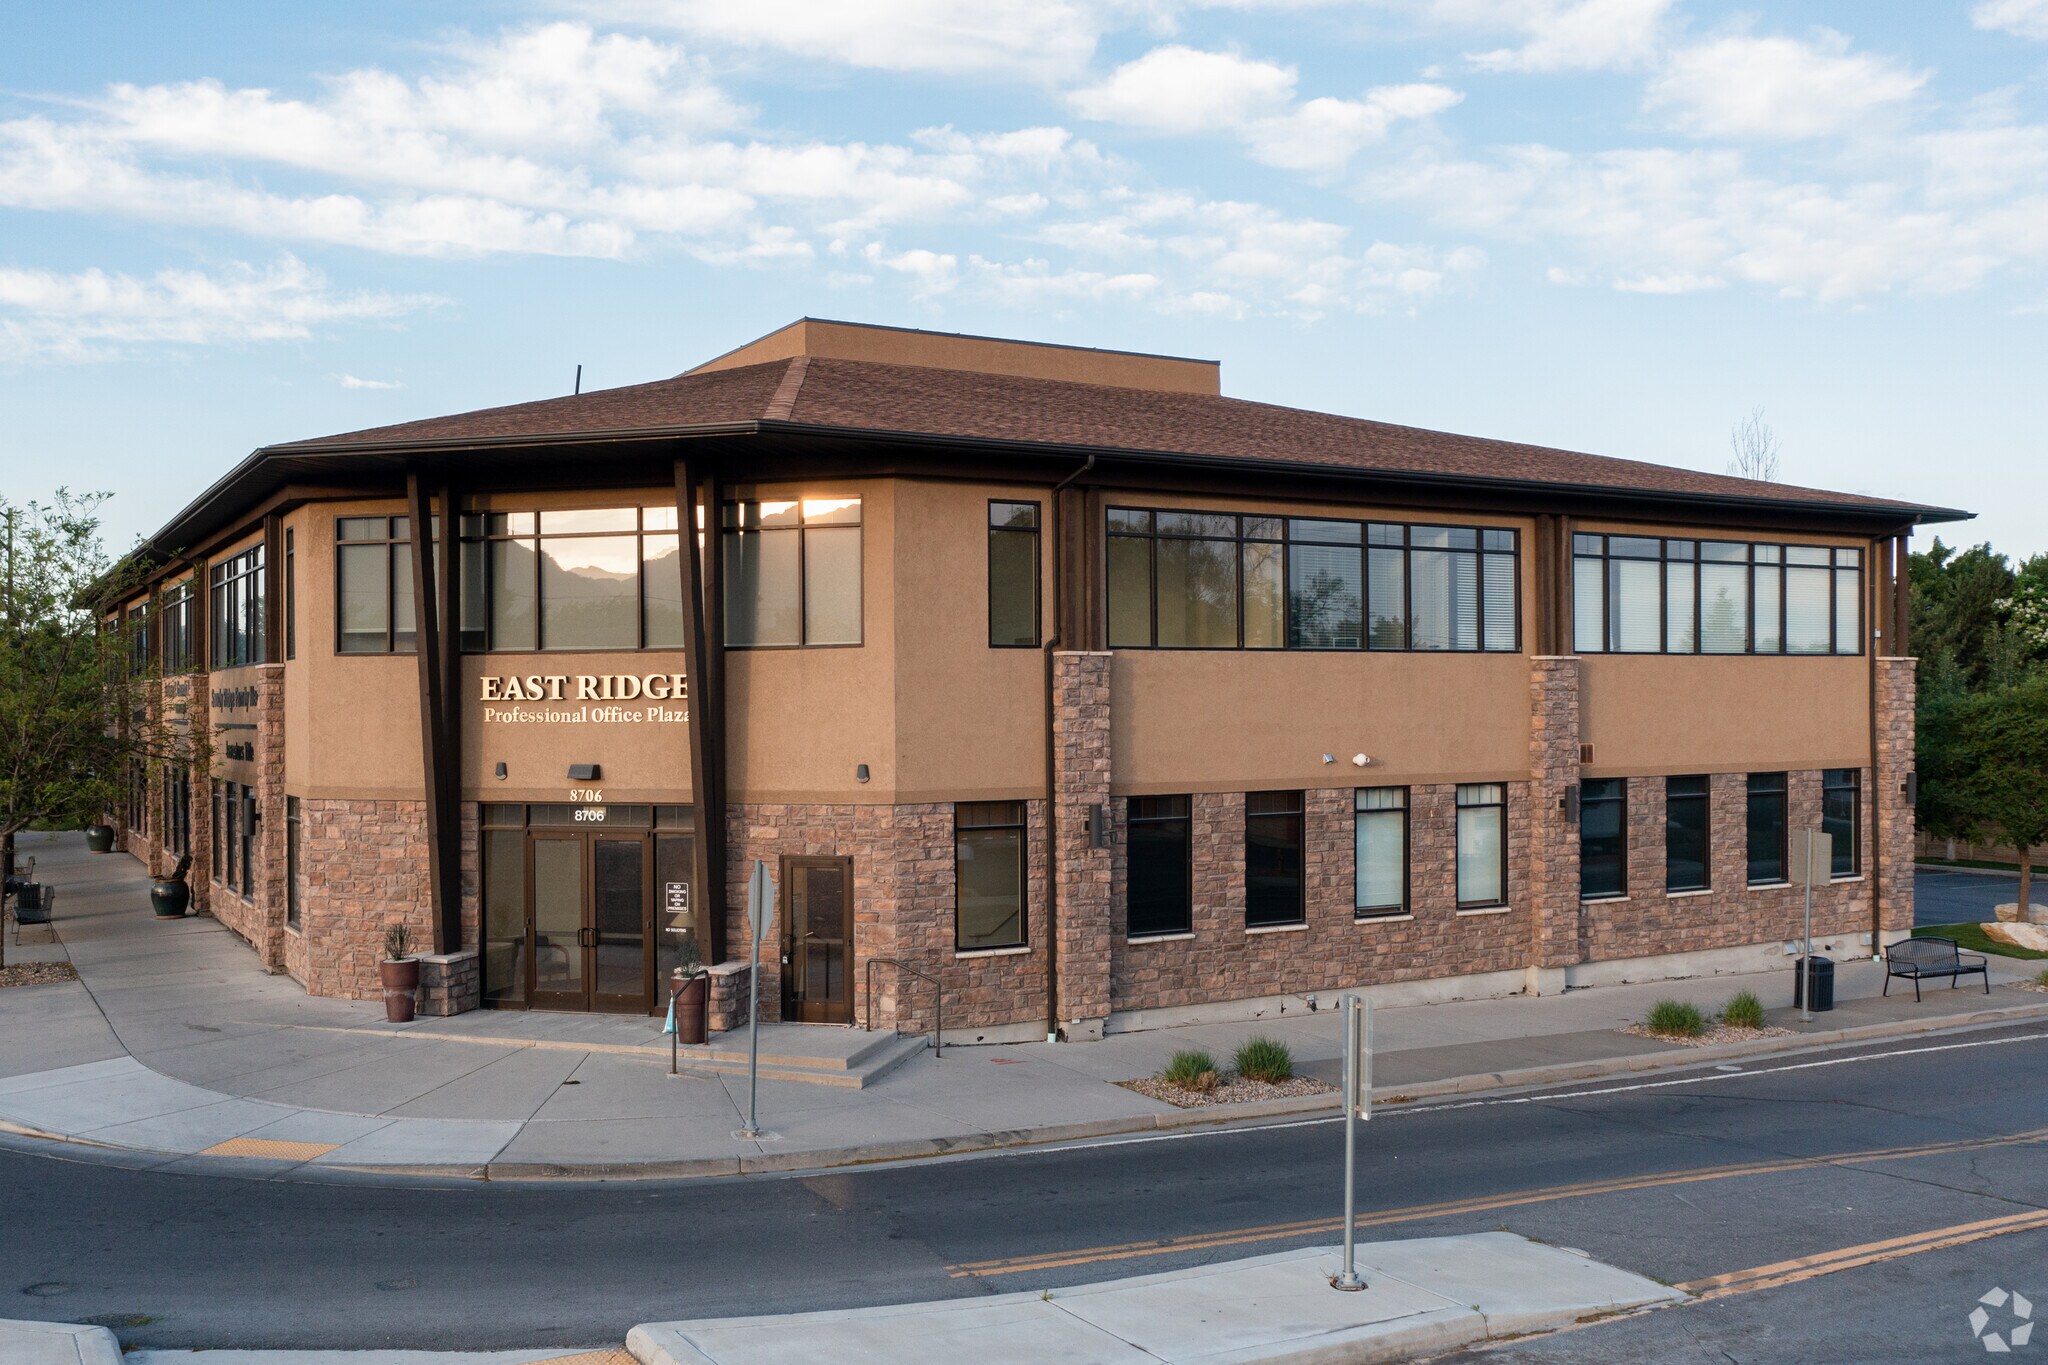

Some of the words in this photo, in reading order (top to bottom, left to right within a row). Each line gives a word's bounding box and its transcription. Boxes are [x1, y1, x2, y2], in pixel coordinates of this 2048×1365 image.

[480, 675, 567, 701] EAST
[576, 674, 688, 701] RIDGE
[484, 706, 588, 723] Professional
[592, 706, 642, 723] Office
[646, 706, 689, 723] Plaza
[570, 789, 602, 802] 8706
[574, 810, 604, 821] 8706
